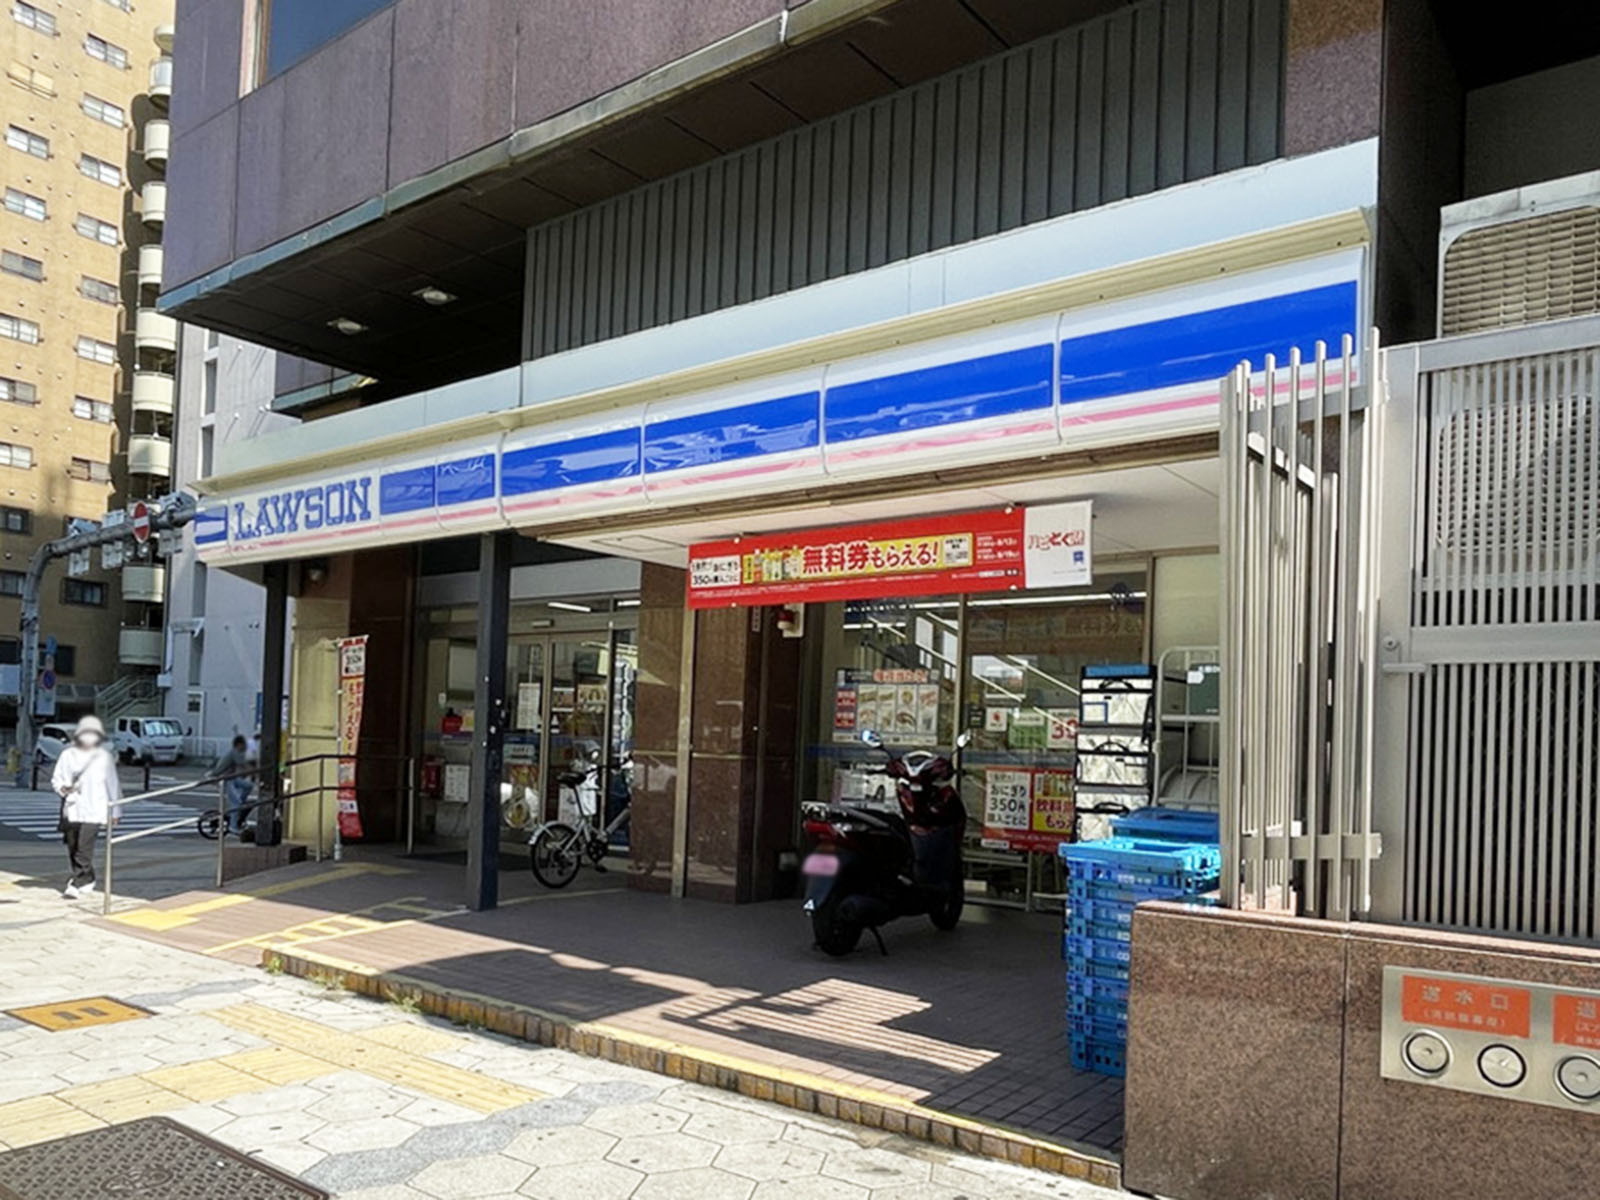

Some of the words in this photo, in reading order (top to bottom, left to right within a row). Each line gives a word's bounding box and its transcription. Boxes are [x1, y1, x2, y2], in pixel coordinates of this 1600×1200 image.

[234, 476, 372, 541] LAWSON
[802, 541, 939, 575] 無料券もらえる!
[990, 784, 1027, 798] おにぎり
[989, 797, 1027, 813] 350円
